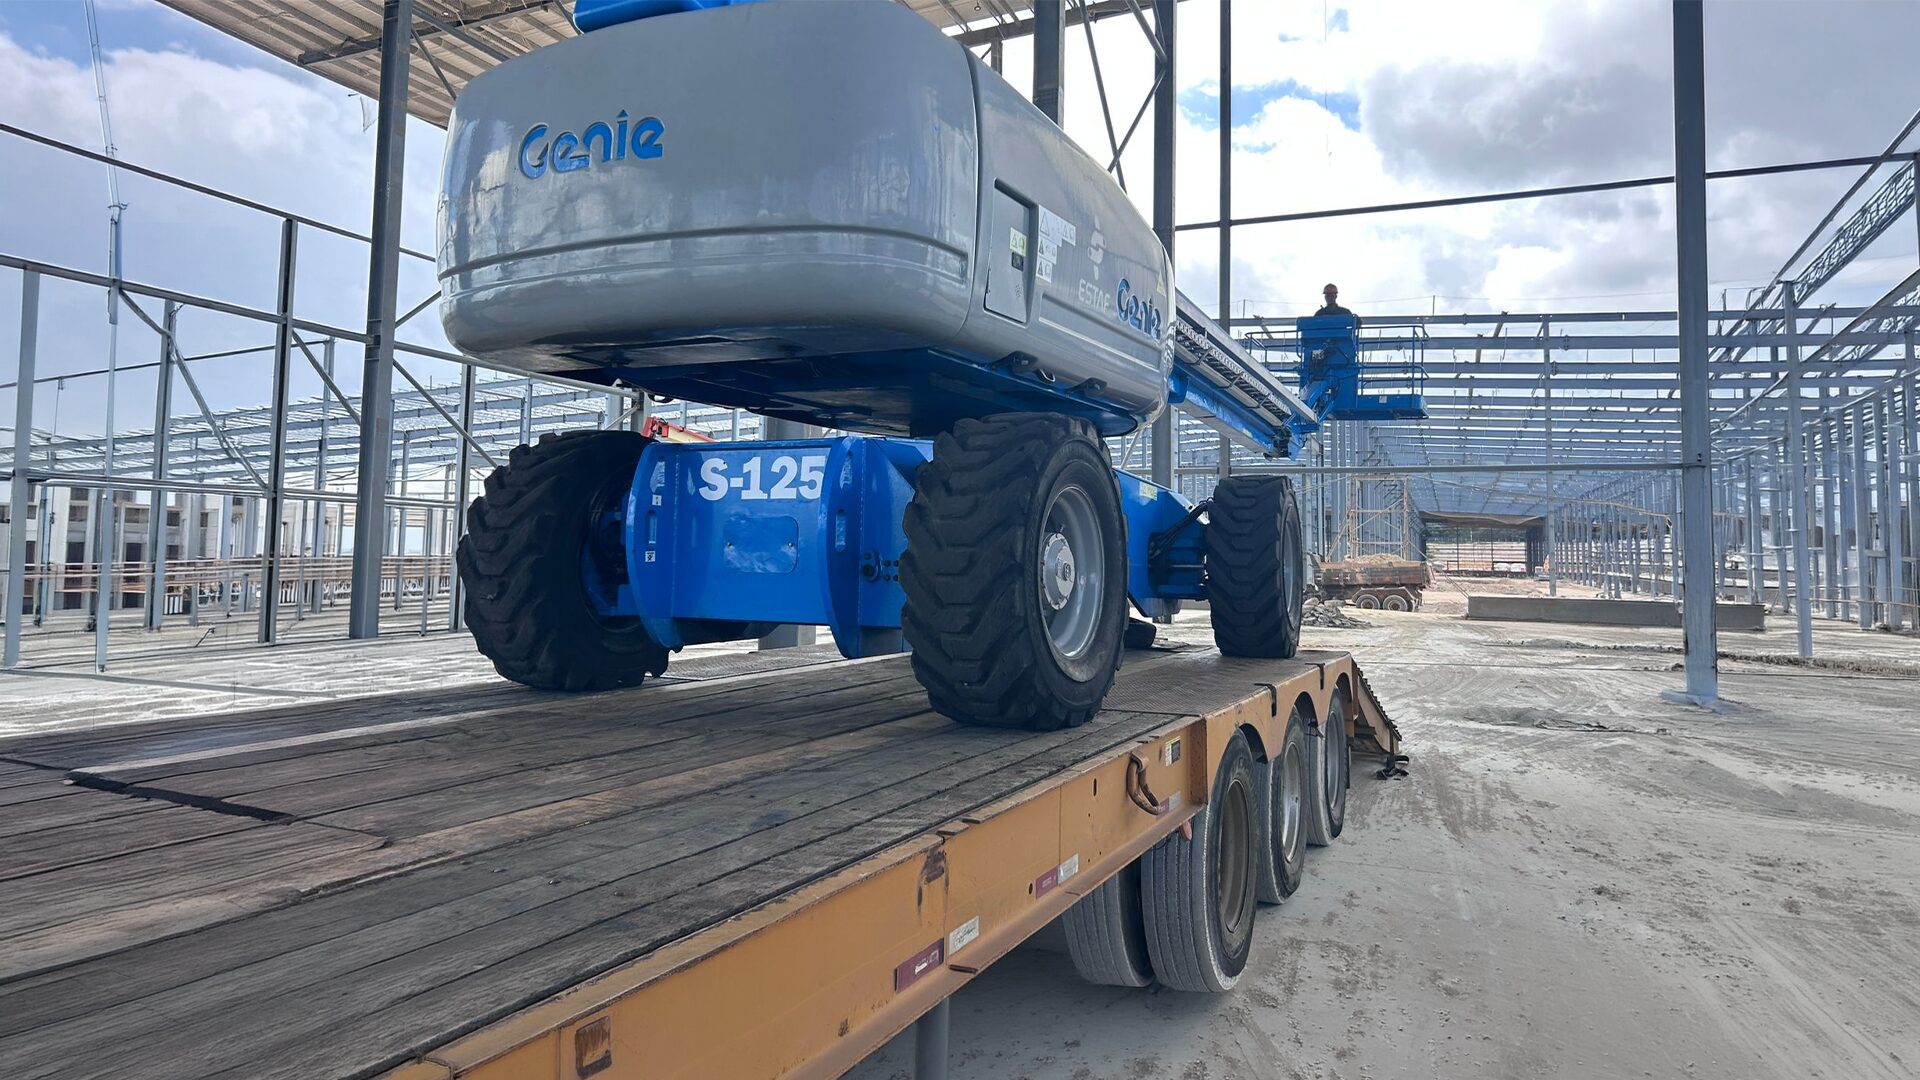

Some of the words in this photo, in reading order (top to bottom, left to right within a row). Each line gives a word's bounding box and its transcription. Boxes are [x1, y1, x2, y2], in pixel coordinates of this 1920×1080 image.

[519, 108, 665, 180] Genie
[1116, 277, 1162, 343] Genie
[699, 455, 827, 501] S-125
